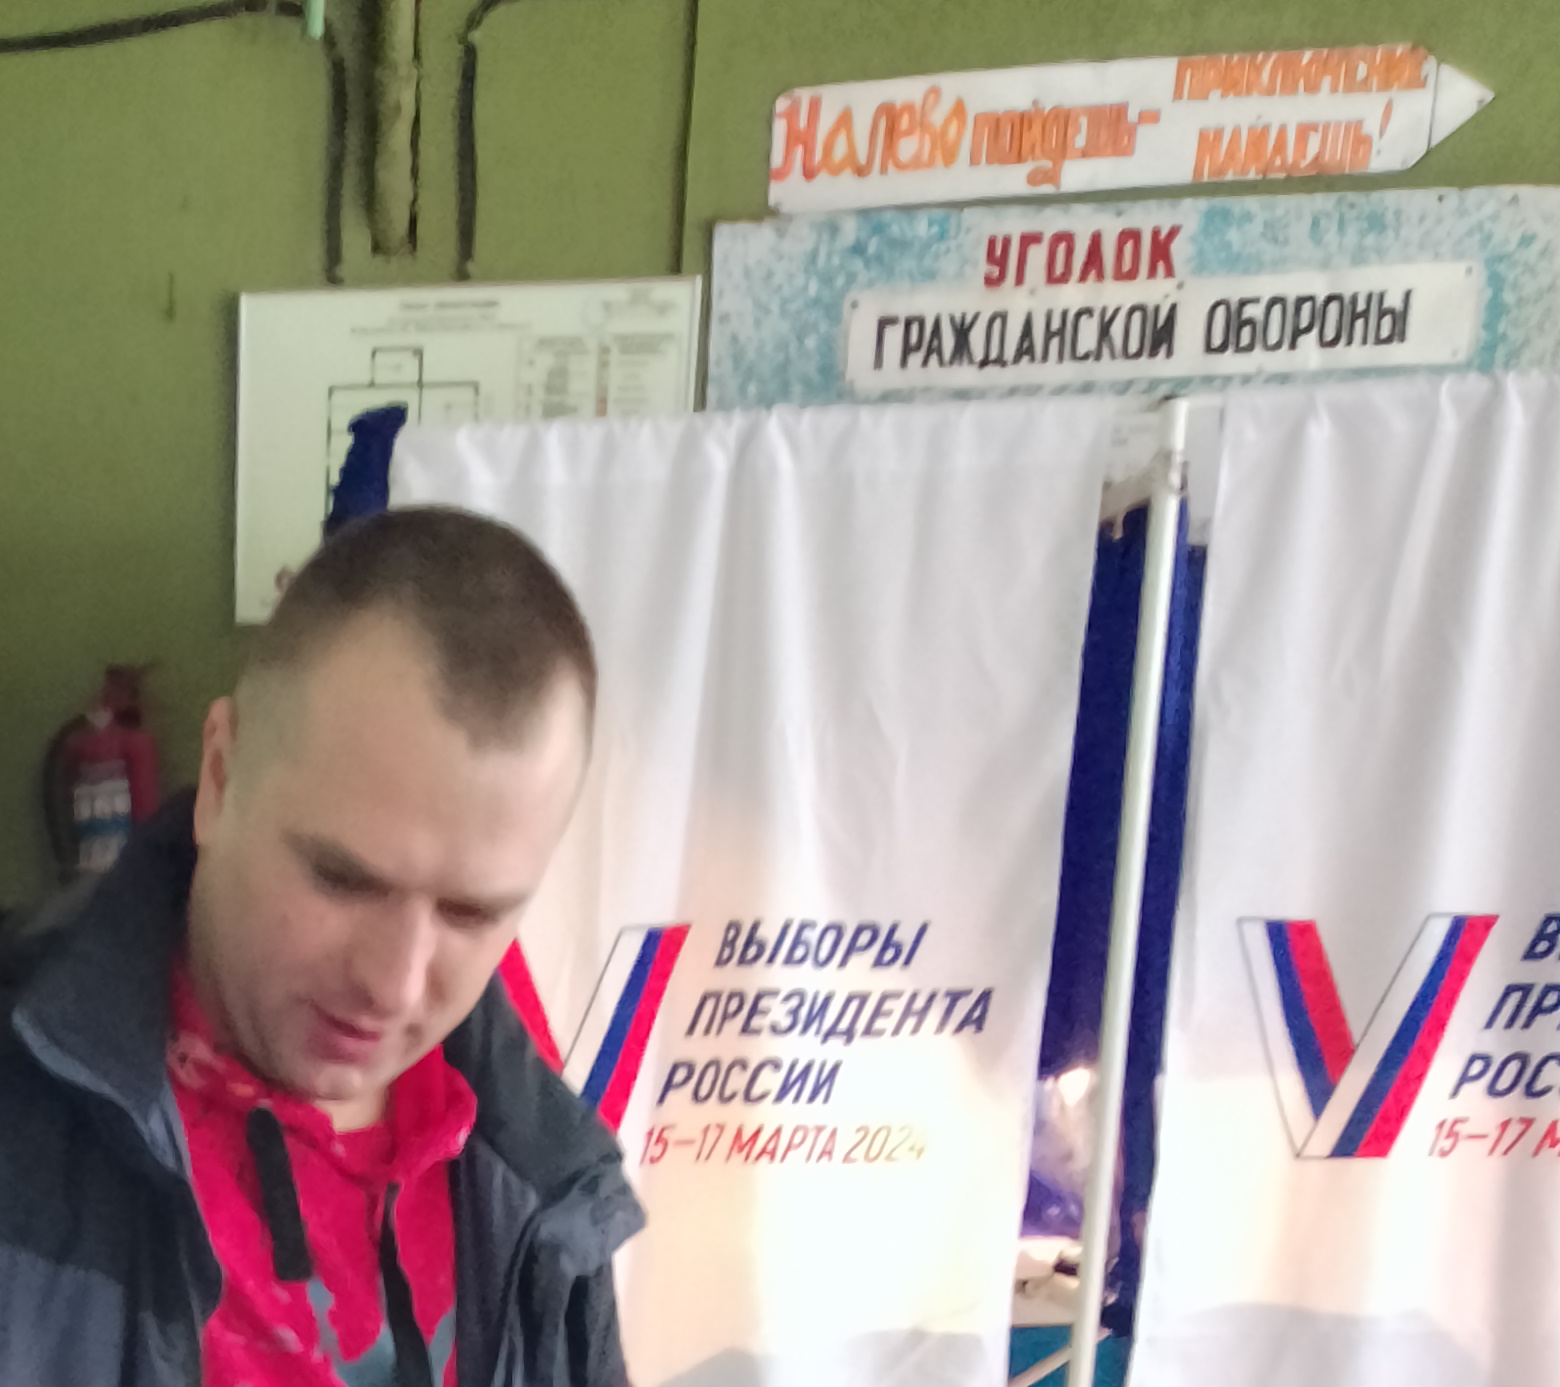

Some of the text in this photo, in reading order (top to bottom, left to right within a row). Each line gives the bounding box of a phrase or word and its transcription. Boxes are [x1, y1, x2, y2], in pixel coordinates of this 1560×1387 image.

[983, 223, 1183, 289] УГОЛОК
[872, 288, 1414, 370] ГРАЖДАНСКОЙ ОБОРОНЫ
[713, 917, 932, 970] ВЫБОРЫ
[1520, 912, 1560, 962] В
[684, 986, 996, 1045] ПРЕЗИДЕНТА
[1483, 983, 1560, 1031] ПР
[655, 1057, 845, 1108] РОССИИ
[1448, 1051, 1560, 1101] РОС
[724, 1122, 839, 1166] МАРТА
